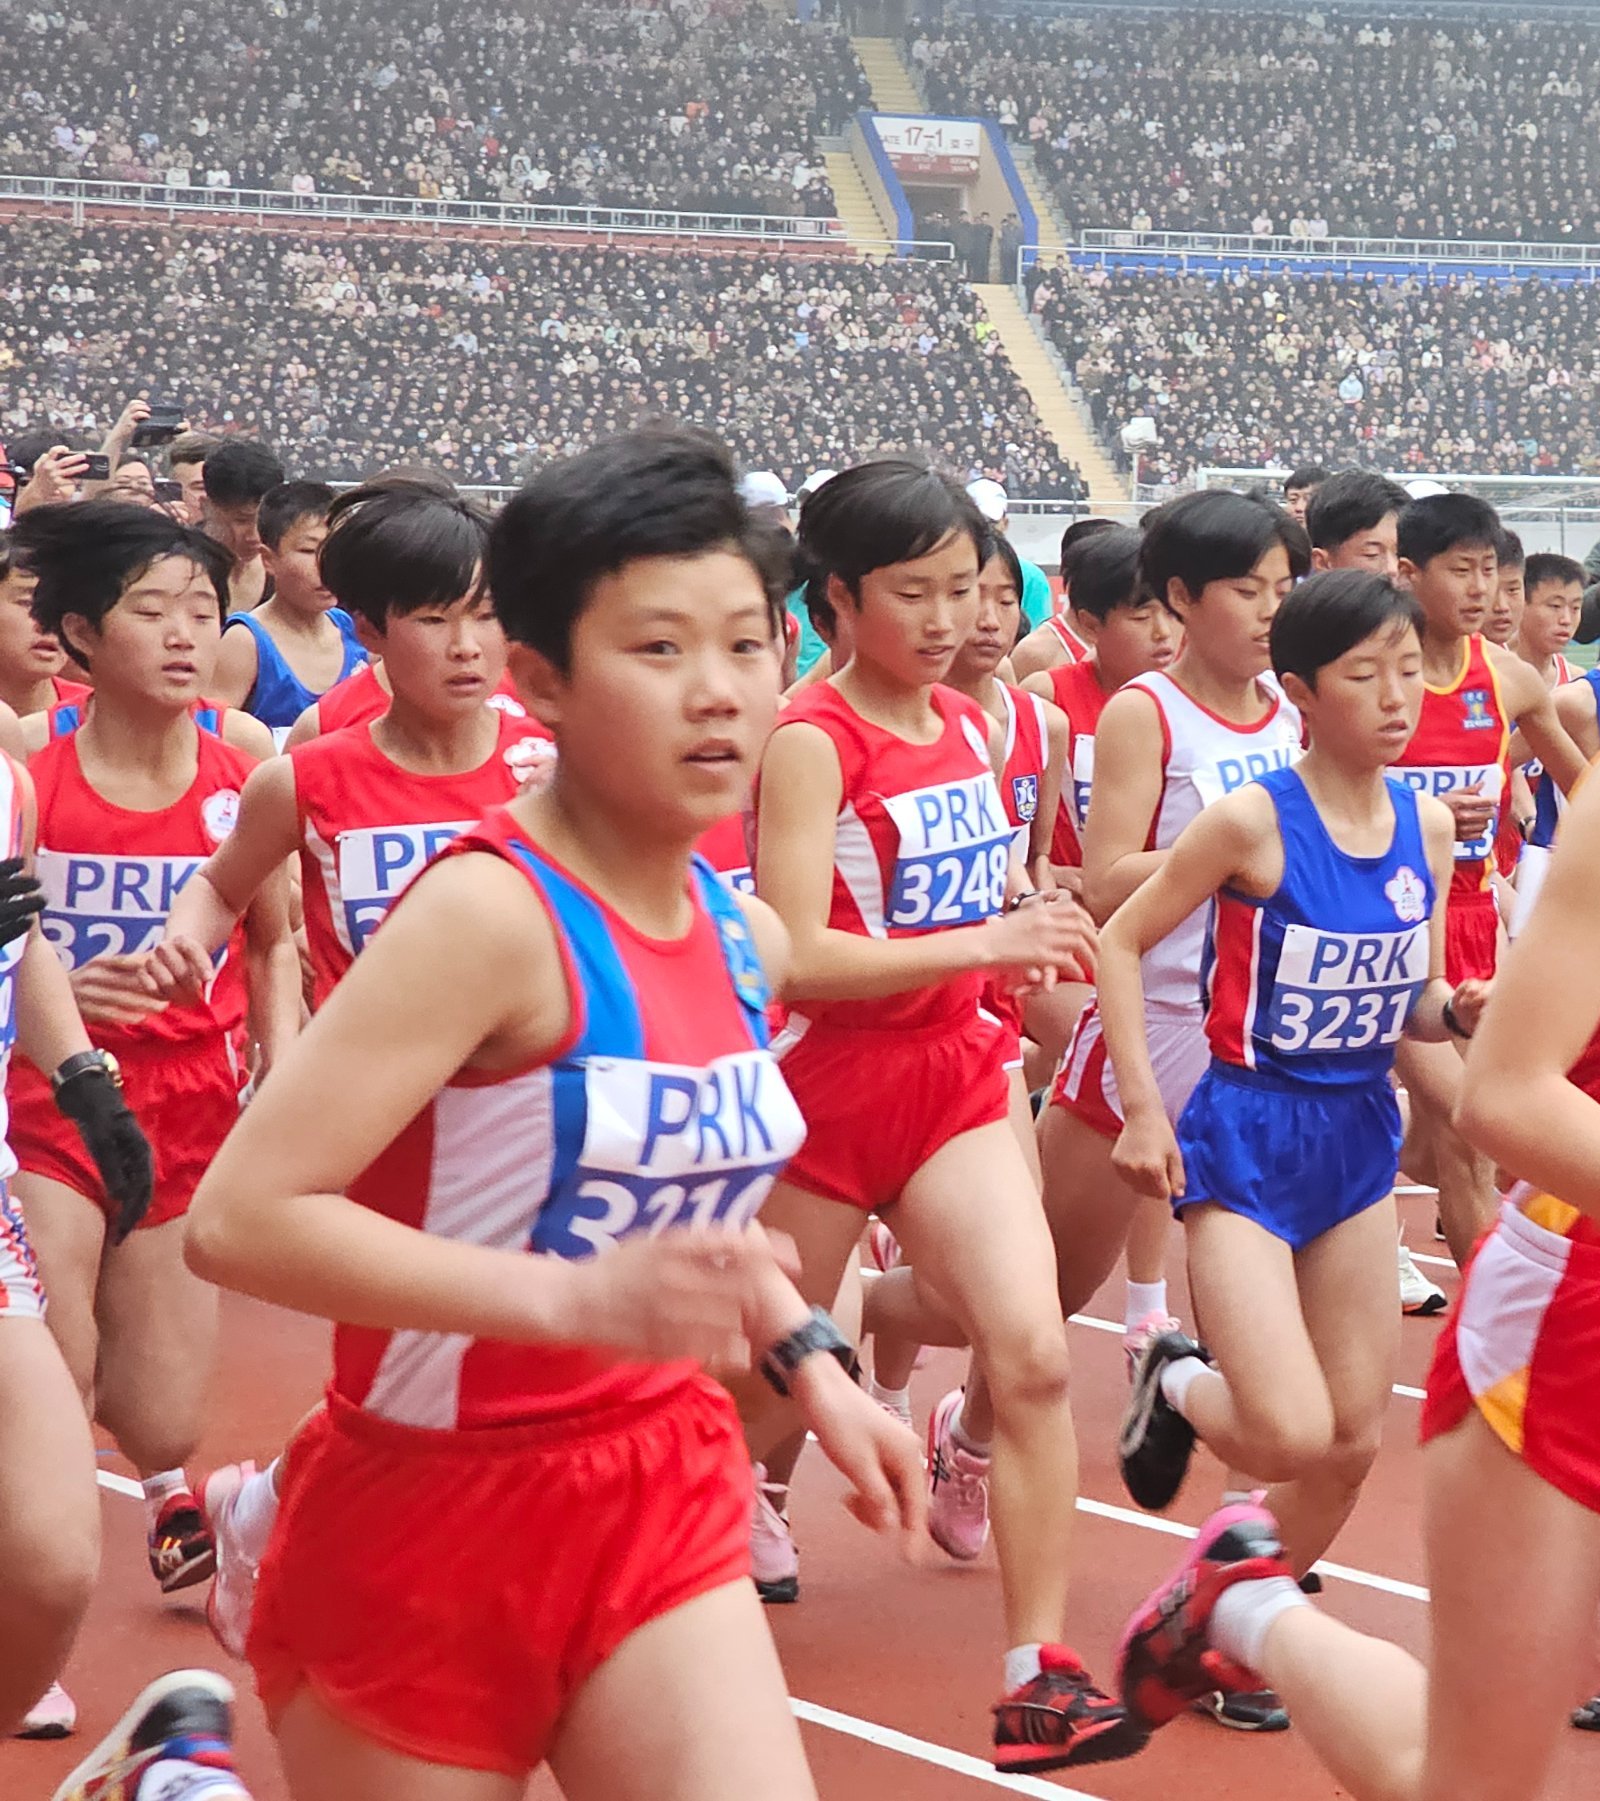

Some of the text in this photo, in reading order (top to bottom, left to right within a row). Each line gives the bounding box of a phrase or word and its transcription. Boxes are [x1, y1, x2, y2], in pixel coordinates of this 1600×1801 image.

[905, 126, 943, 147] 17-1
[914, 780, 997, 849] PRK
[65, 860, 201, 912] PRK
[892, 844, 1009, 925] 3248
[1308, 932, 1417, 984] PRK
[1270, 989, 1412, 1052] 3231
[638, 1061, 774, 1166] PRK
